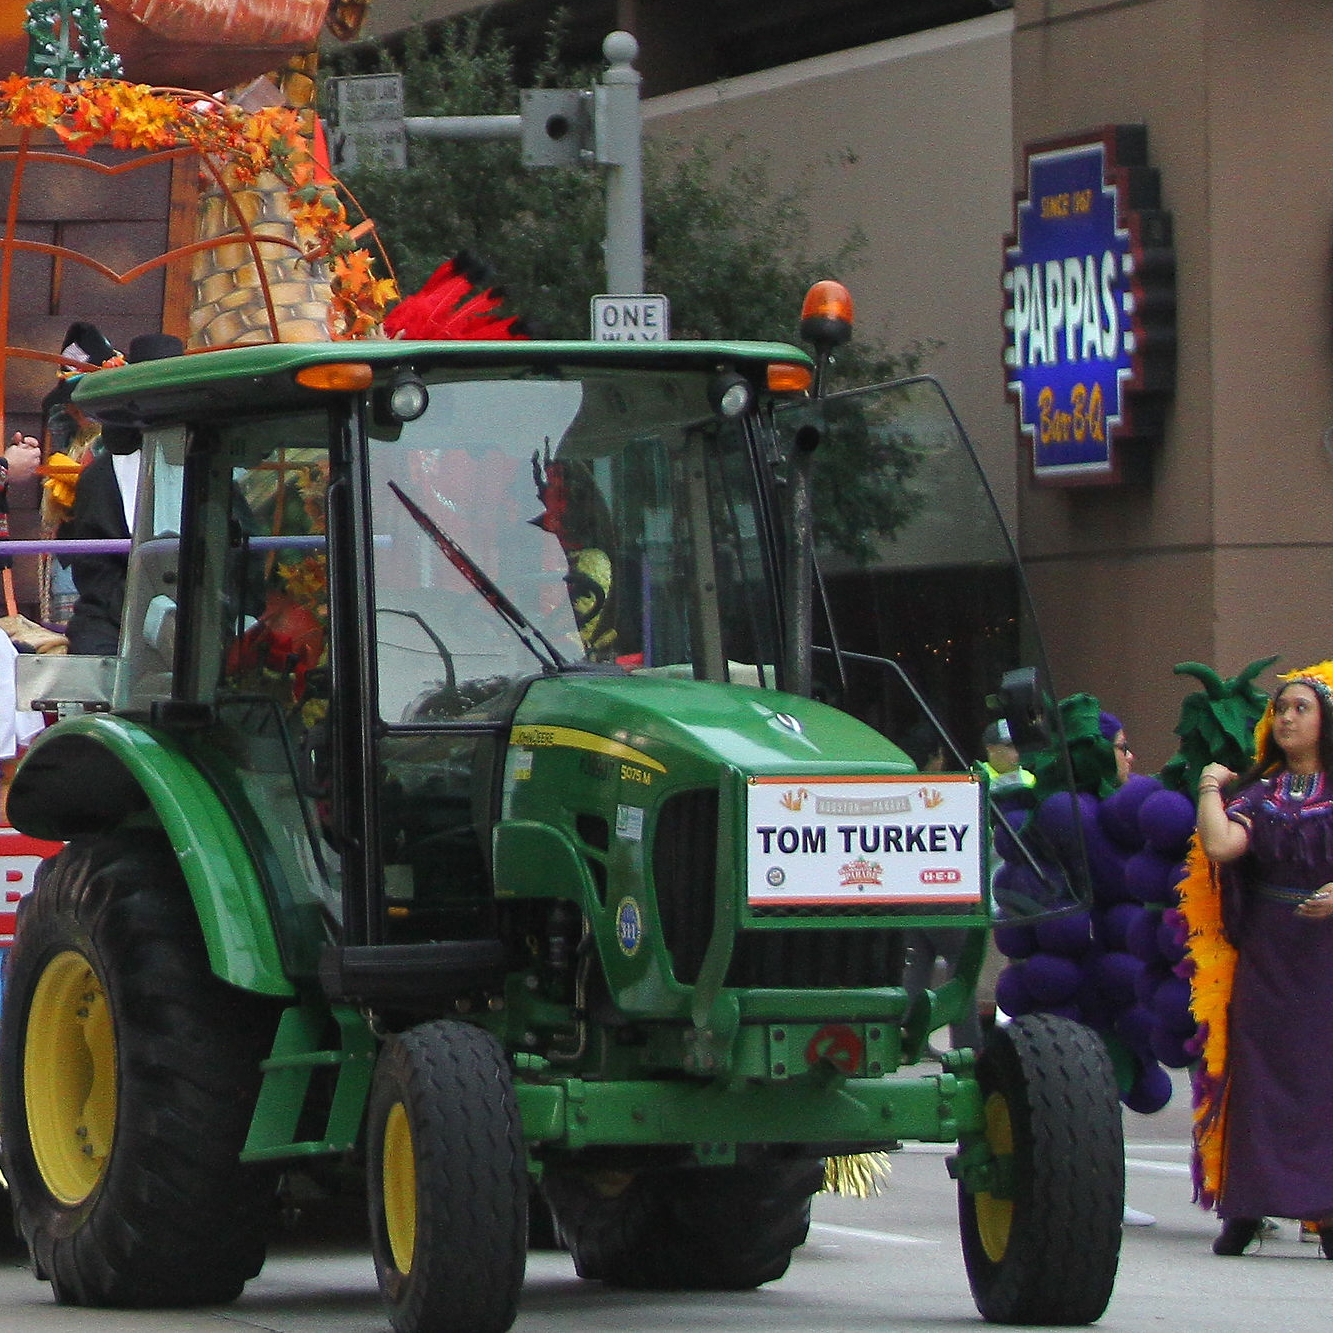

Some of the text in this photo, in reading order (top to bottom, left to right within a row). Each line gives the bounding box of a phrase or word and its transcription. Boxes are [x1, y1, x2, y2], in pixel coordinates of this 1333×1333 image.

[603, 305, 657, 326] ONE
[1013, 250, 1119, 367] PAPPAS
[756, 824, 969, 854] TOM TURKEY
